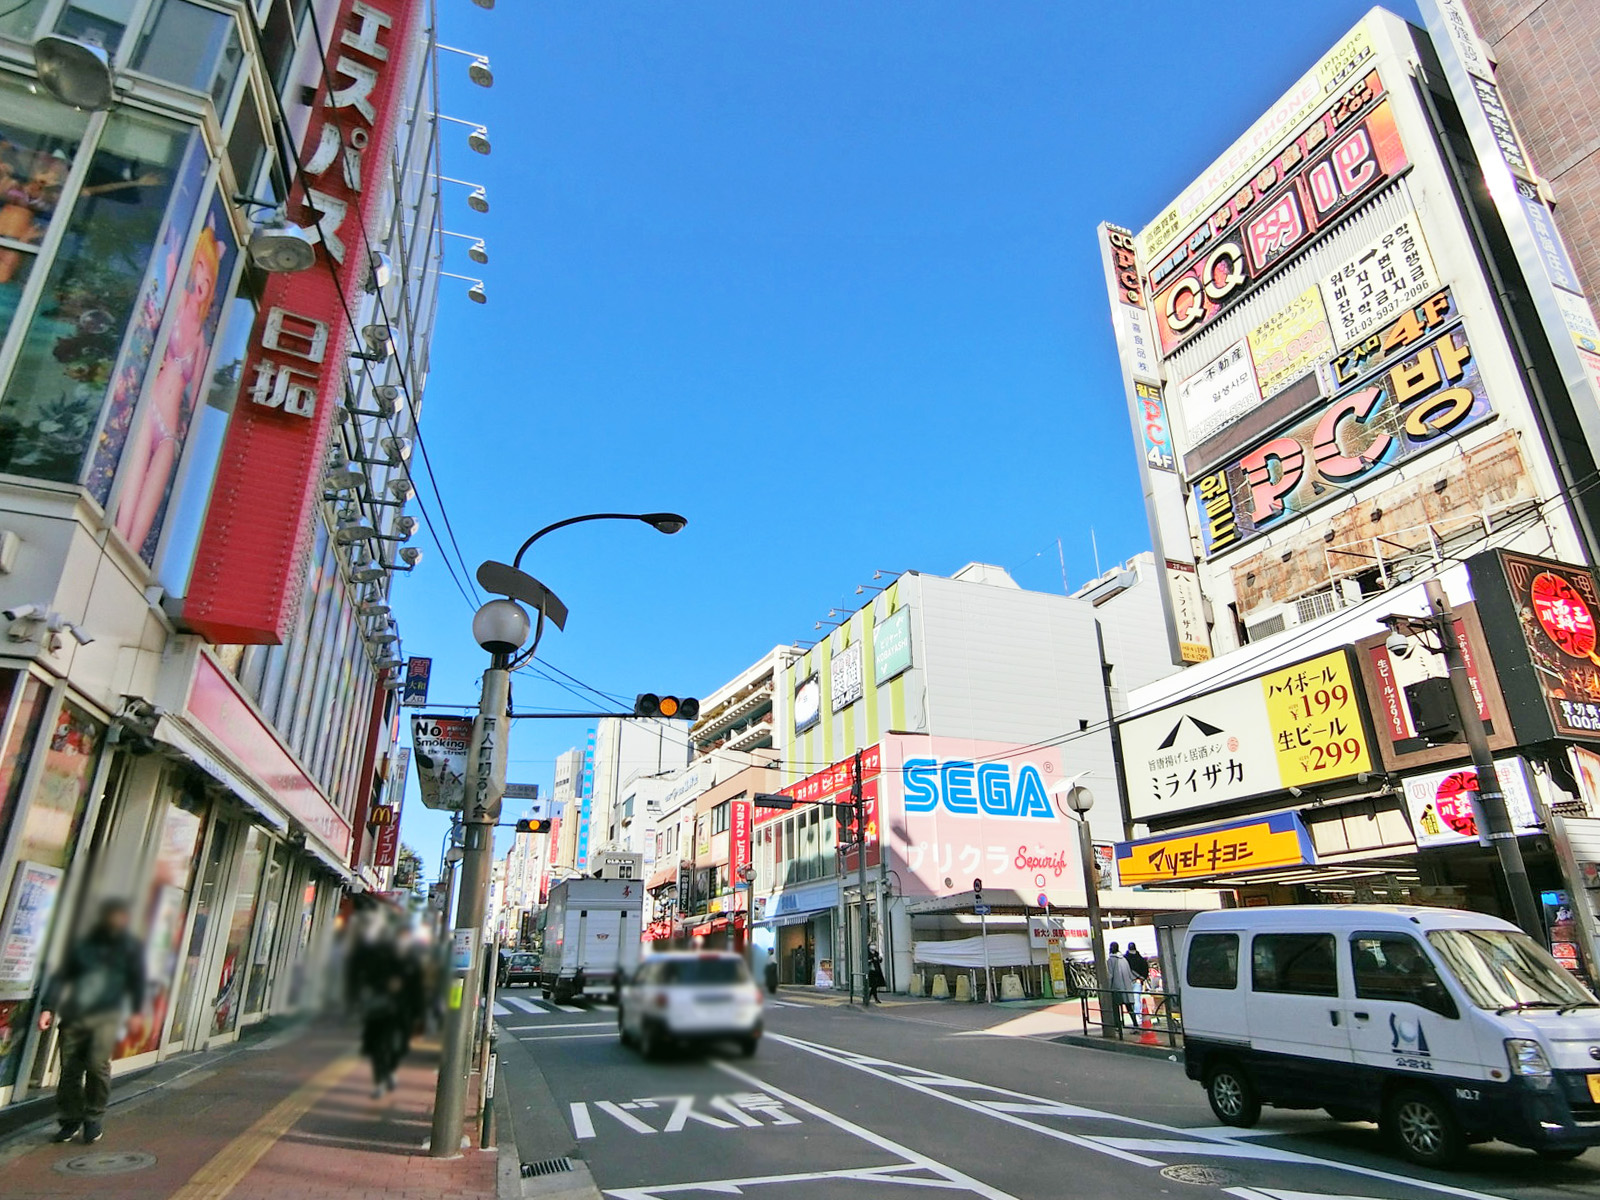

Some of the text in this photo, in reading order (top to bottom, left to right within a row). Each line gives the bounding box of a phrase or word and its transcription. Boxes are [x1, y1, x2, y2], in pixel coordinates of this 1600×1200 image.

[1320, 32, 1362, 75] iPhone
[1207, 83, 1316, 189] KEEP PHONE
[247, 2, 393, 418] エスパス 日拓
[1344, 279, 1429, 340] TEL:03-5937-2096
[1383, 292, 1448, 351] 4F
[1353, 335, 1379, 361] 入口
[1148, 446, 1173, 468] 4F
[409, 659, 430, 677] 質
[876, 640, 908, 664] KOBAYASHI
[1268, 666, 1338, 699] ハイボール
[1290, 684, 1348, 721] ¥199
[415, 737, 465, 750] Smoking
[416, 721, 442, 737] No
[1278, 717, 1349, 752] 生ビール
[1301, 737, 1361, 772] ¥299
[797, 782, 818, 800] カラオケ
[903, 759, 1054, 818] SEGA
[1152, 758, 1244, 800] ミライザカ
[735, 803, 745, 837] カラオケ
[379, 824, 396, 865] アイフル
[903, 841, 1009, 875] プリクラ
[1148, 839, 1253, 876] マツモトキヨシ
[1456, 1088, 1480, 1100] NO.7
[570, 1093, 803, 1139] バス停
